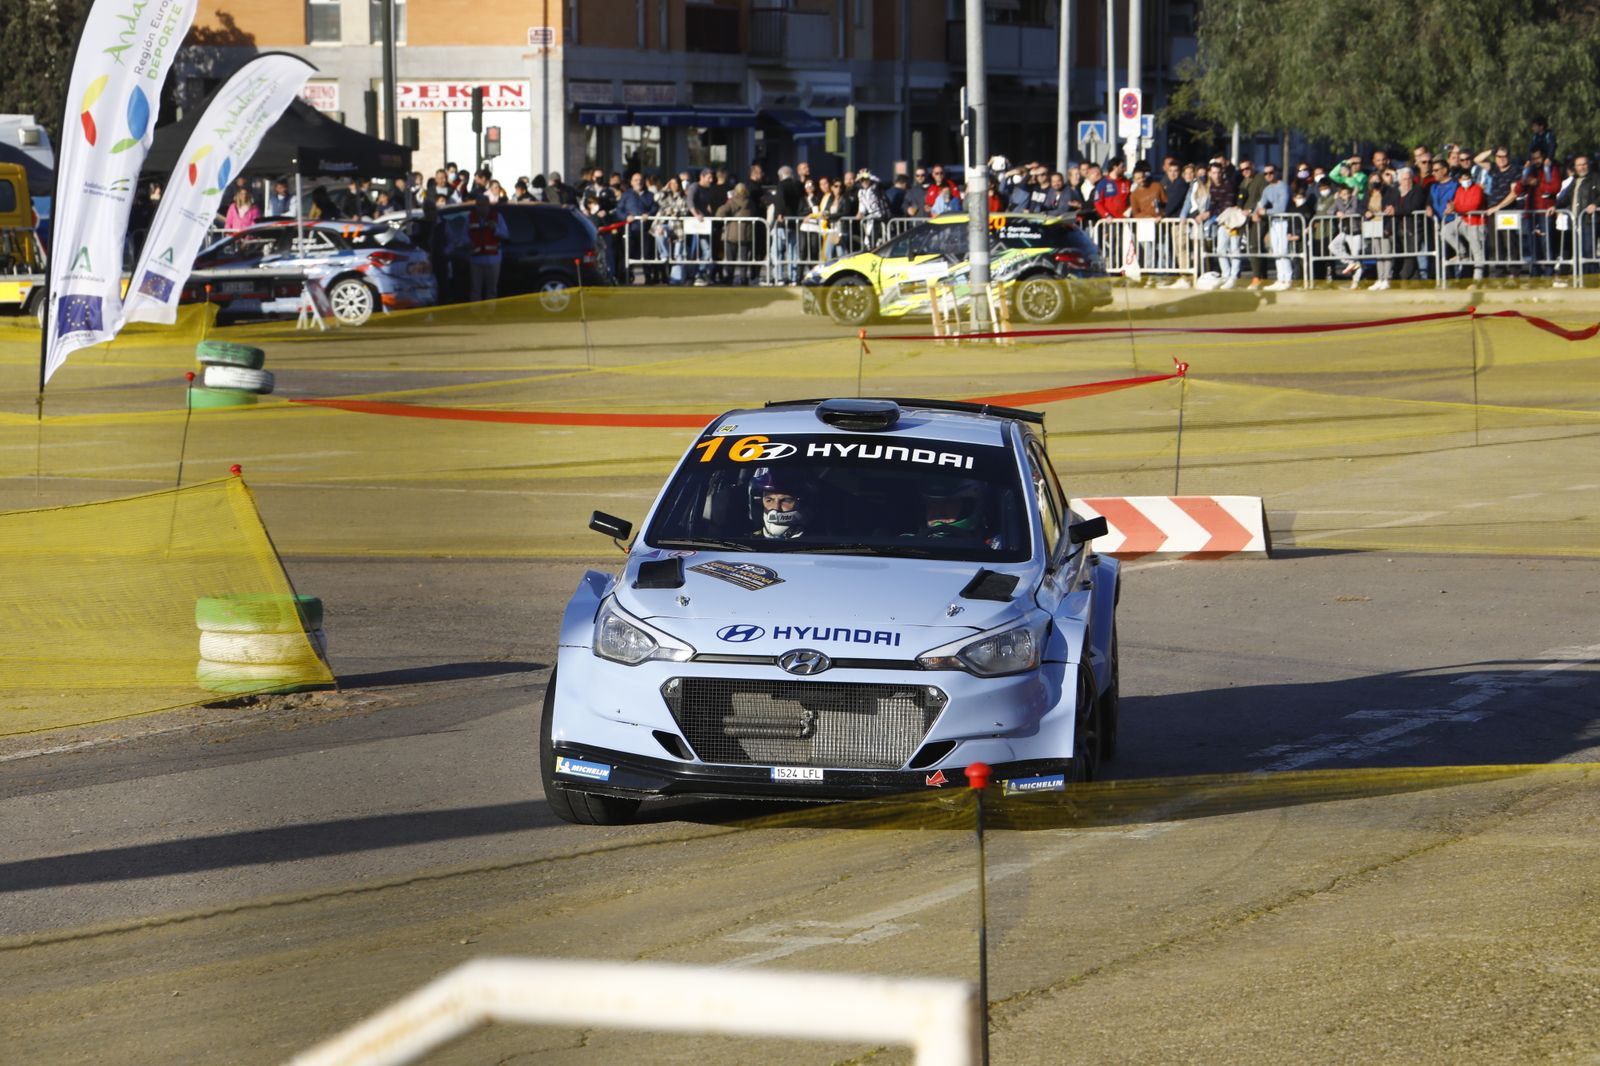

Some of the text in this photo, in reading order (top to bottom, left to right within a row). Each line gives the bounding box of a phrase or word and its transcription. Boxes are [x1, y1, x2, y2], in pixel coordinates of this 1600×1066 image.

[133, 0, 175, 75] Región Euro
[147, 4, 183, 80] DEPORTE
[396, 85, 524, 99] PEKIN
[234, 111, 269, 157] DEPORTE
[696, 436, 769, 462] 16
[807, 443, 974, 470] HYUNDAI
[773, 626, 901, 647] HYUNDAI
[571, 764, 610, 777] MICHELIN
[777, 768, 821, 779] 1524 LFL
[1019, 779, 1064, 790] MICHELIN
